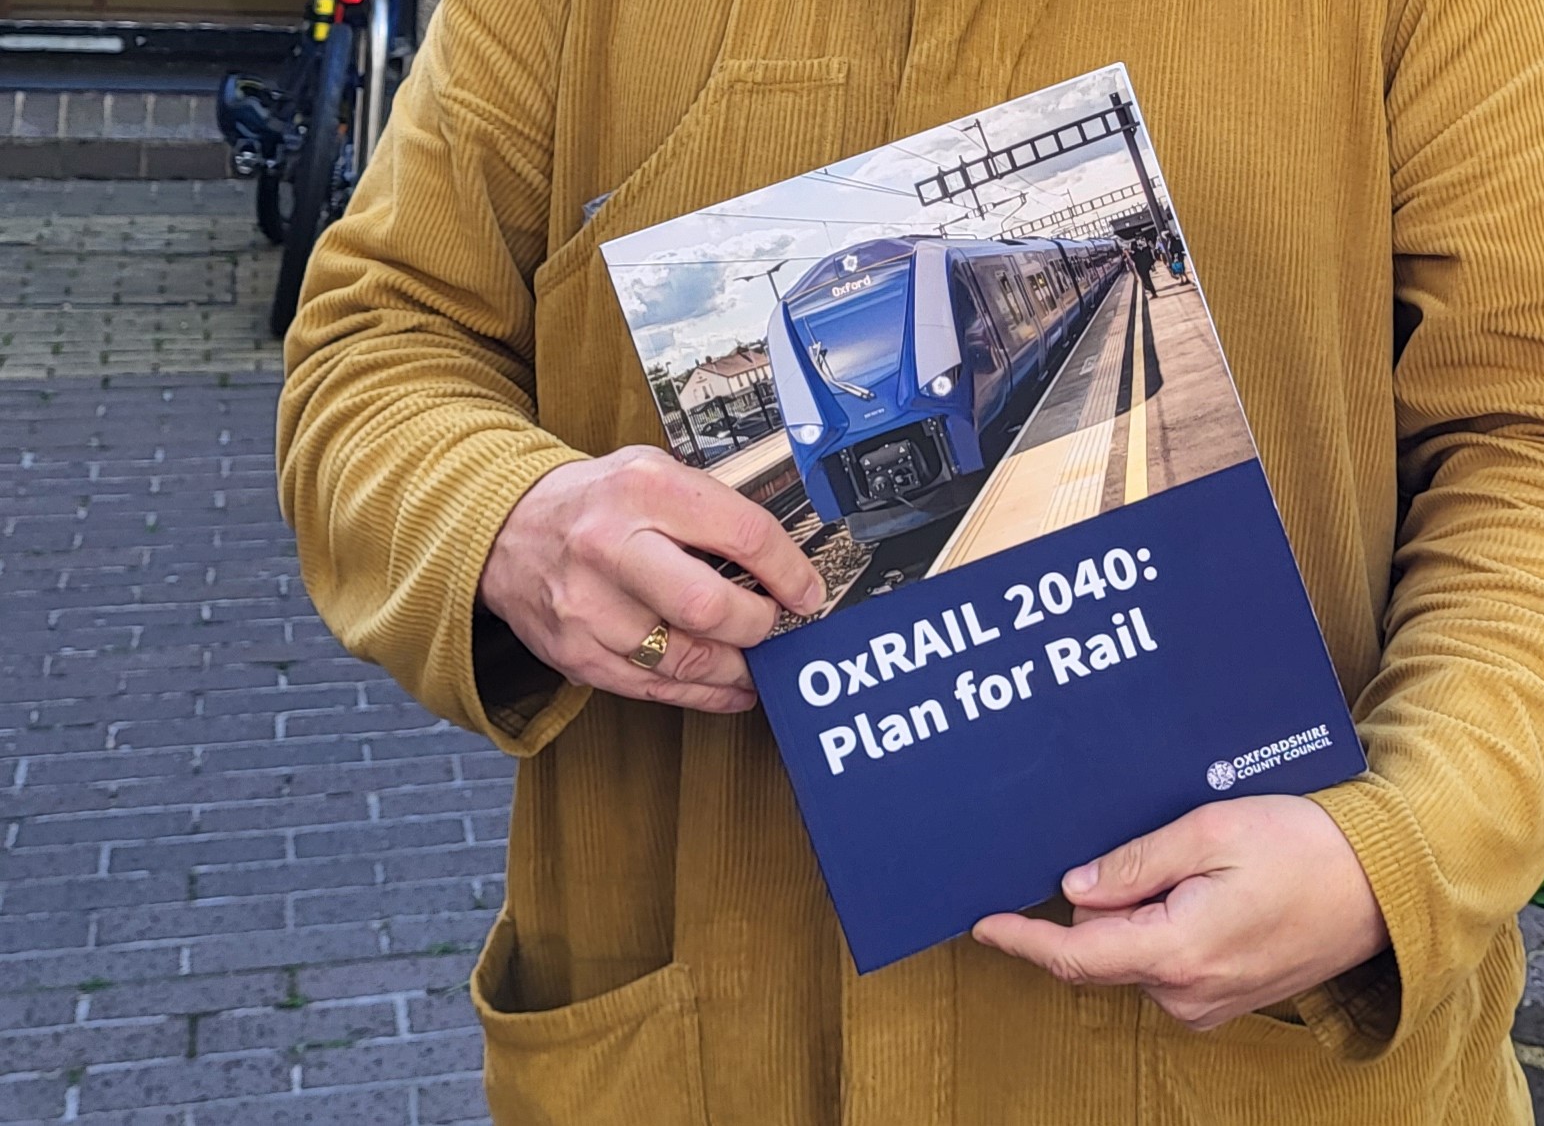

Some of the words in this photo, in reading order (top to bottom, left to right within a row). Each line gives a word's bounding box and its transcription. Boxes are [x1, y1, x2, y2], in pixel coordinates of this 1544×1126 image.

[831, 274, 872, 297] Oxford
[798, 602, 1000, 707] OxRAIL
[1003, 546, 1158, 630] 2040:
[818, 699, 948, 775] Plan
[953, 659, 1036, 721] for
[1045, 607, 1159, 685] Rail
[1233, 724, 1330, 769] OXFORDSHIRE
[1237, 755, 1281, 780] COUNTY
[1283, 736, 1333, 762] COUNCIL
